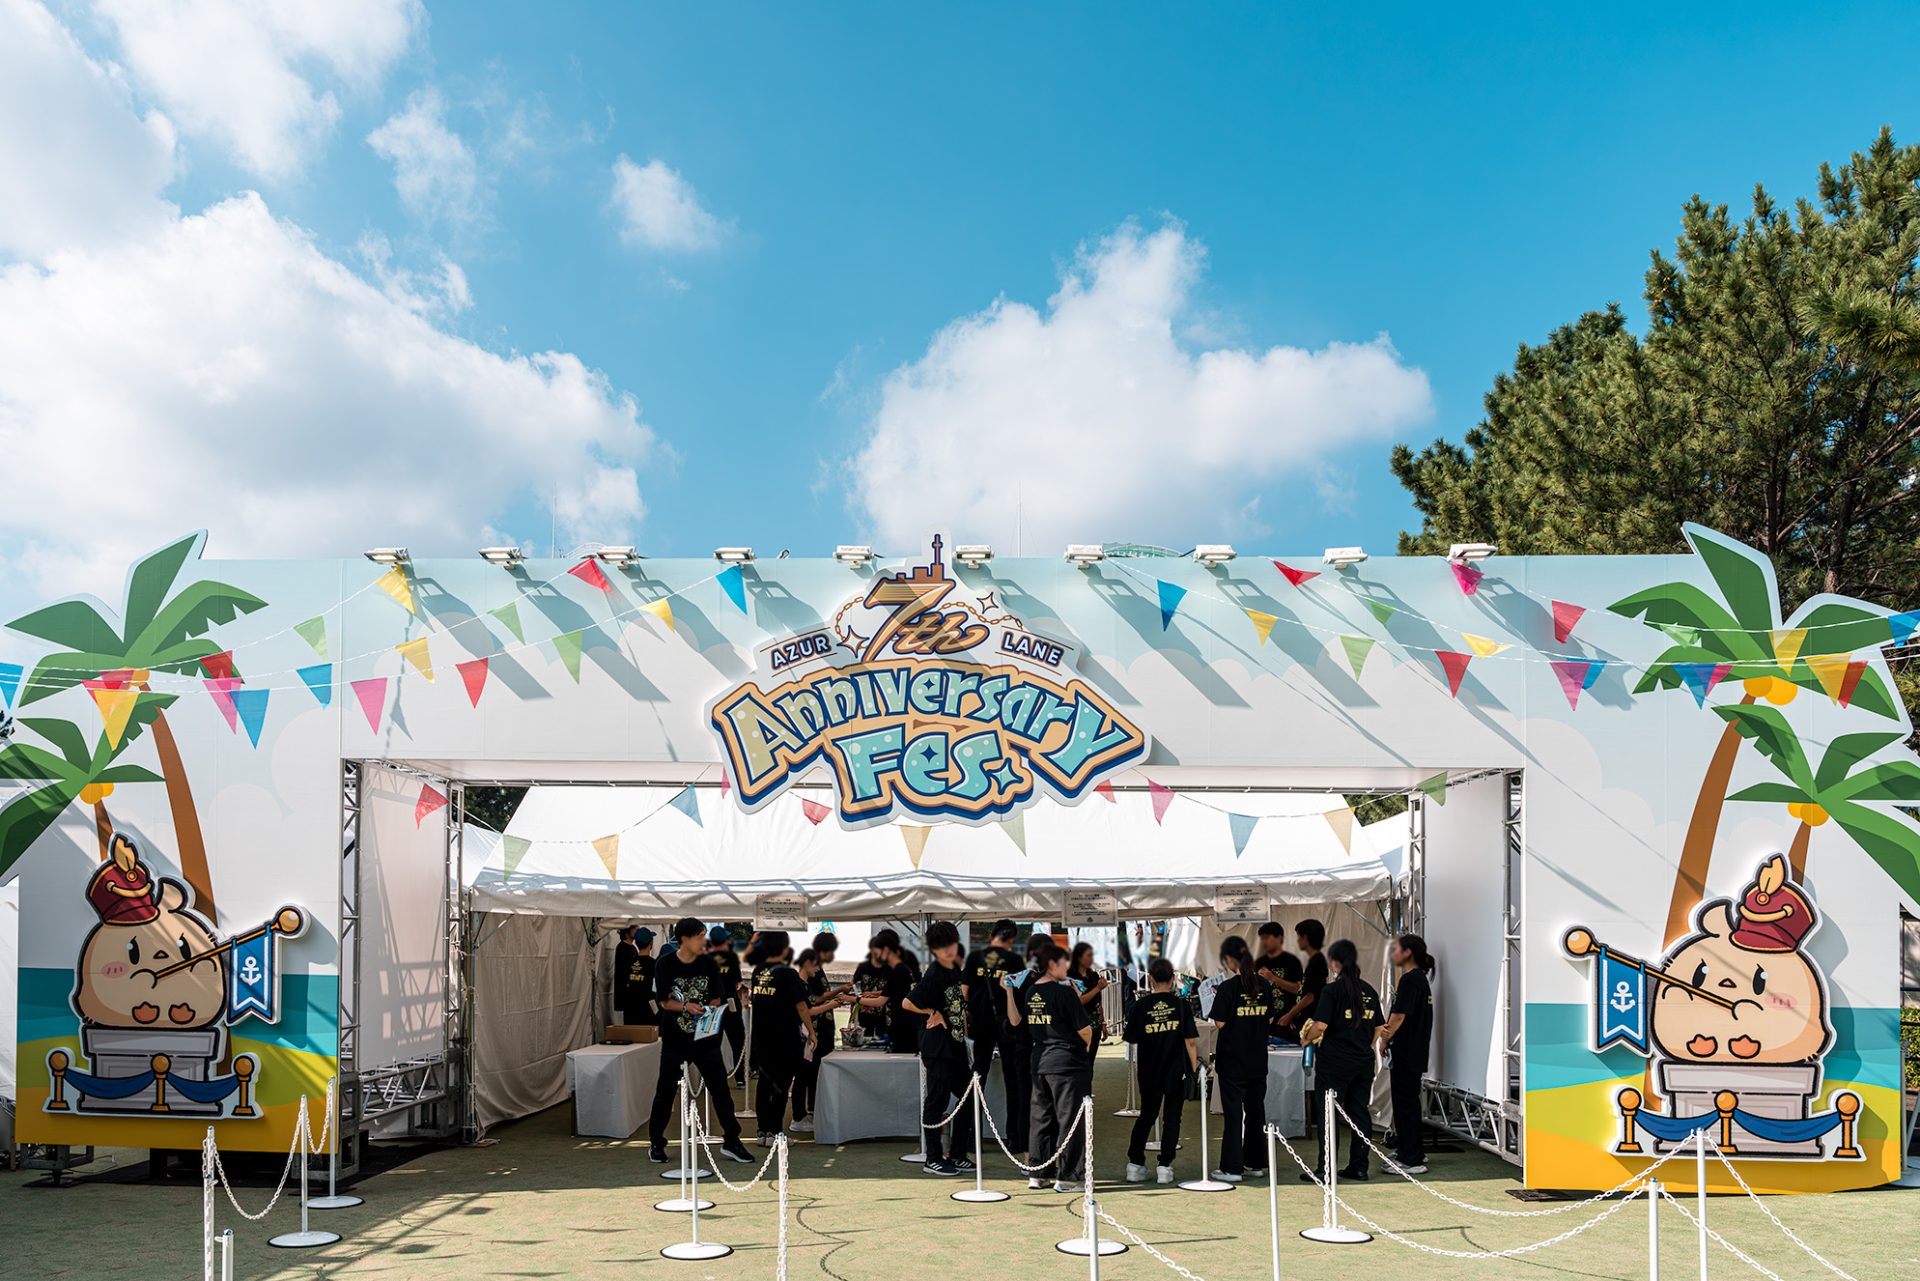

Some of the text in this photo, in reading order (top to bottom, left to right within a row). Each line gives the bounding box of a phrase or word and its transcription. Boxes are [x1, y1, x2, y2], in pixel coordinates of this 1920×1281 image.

[864, 577, 990, 662] 7th
[772, 633, 1062, 668] AZUR LANE
[726, 666, 1131, 782] Anniversary
[1027, 1014, 1052, 1025] STAFF
[1236, 1006, 1268, 1016] STAFF
[1144, 1020, 1180, 1034] STAFF
